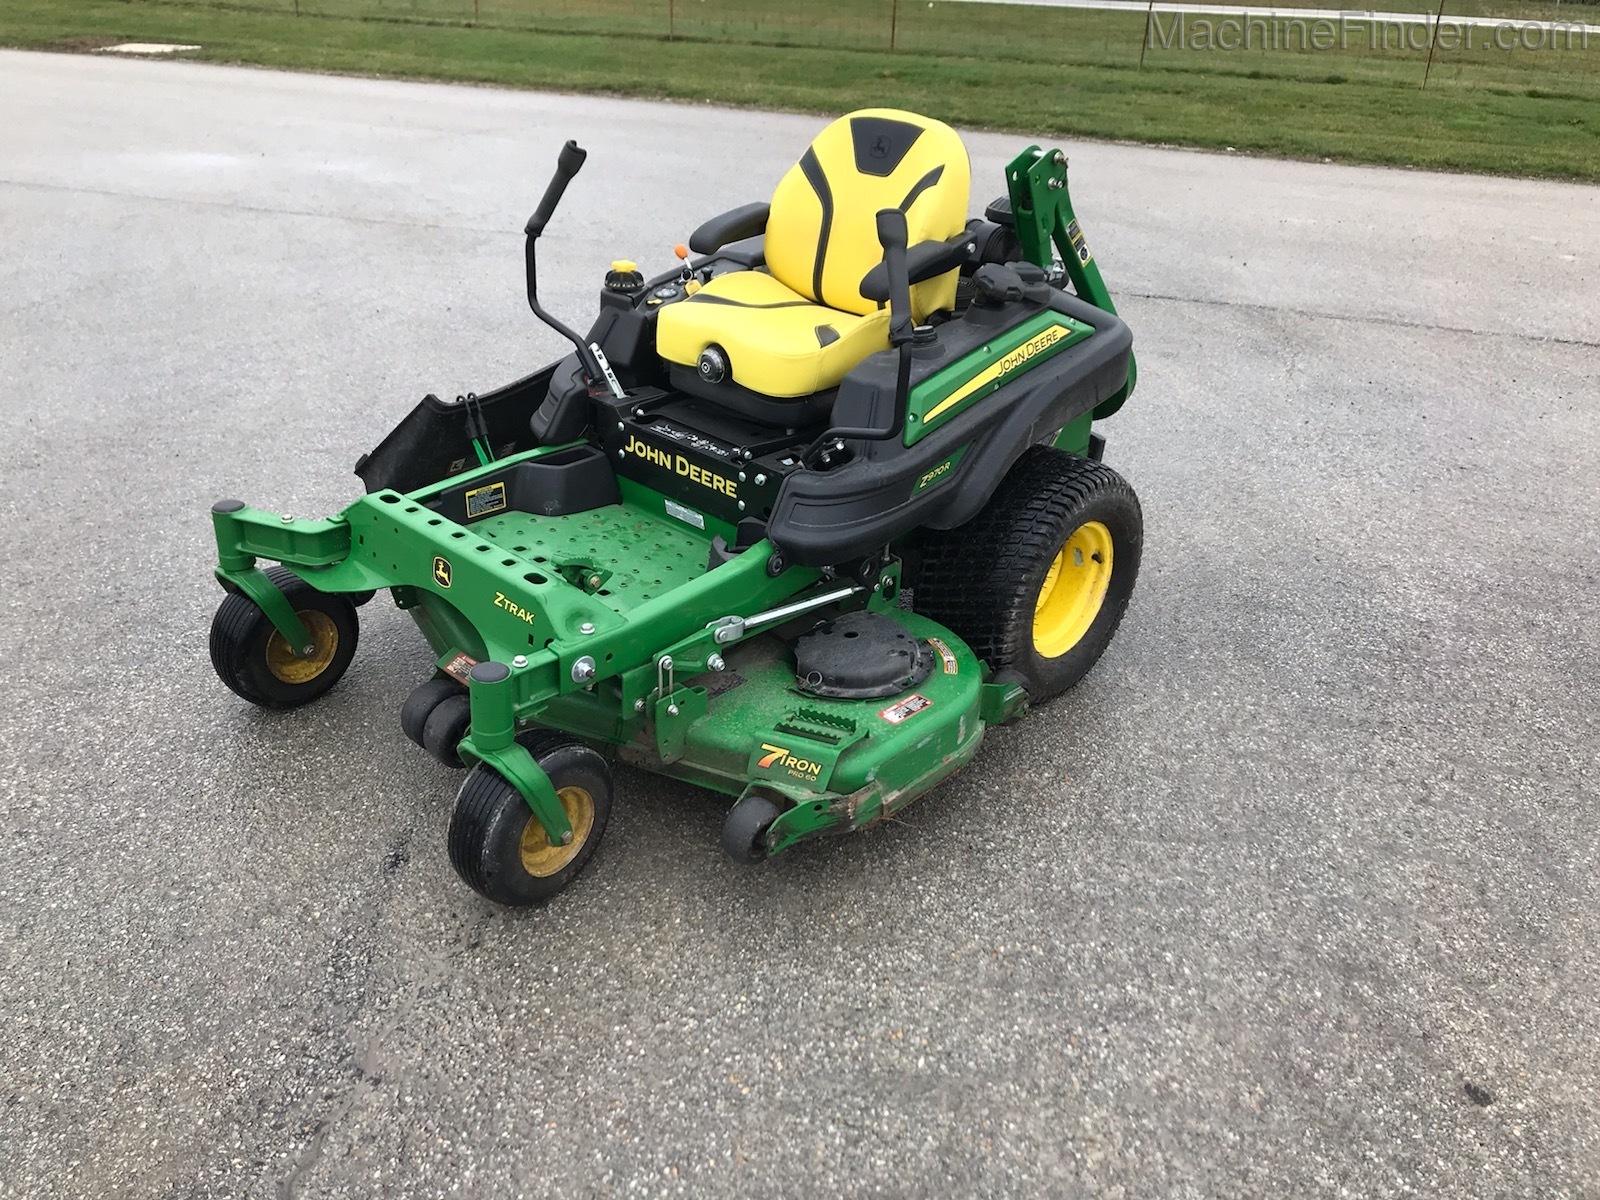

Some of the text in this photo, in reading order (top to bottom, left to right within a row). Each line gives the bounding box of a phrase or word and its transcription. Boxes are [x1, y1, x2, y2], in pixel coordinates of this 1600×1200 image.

[997, 330, 1059, 376] JOHN DEERE
[625, 435, 671, 470] JOHN
[676, 455, 737, 499] DEERE
[919, 461, 951, 488] Z970R
[493, 592, 535, 625] ZTRAK
[787, 769, 817, 782] PRO 60
